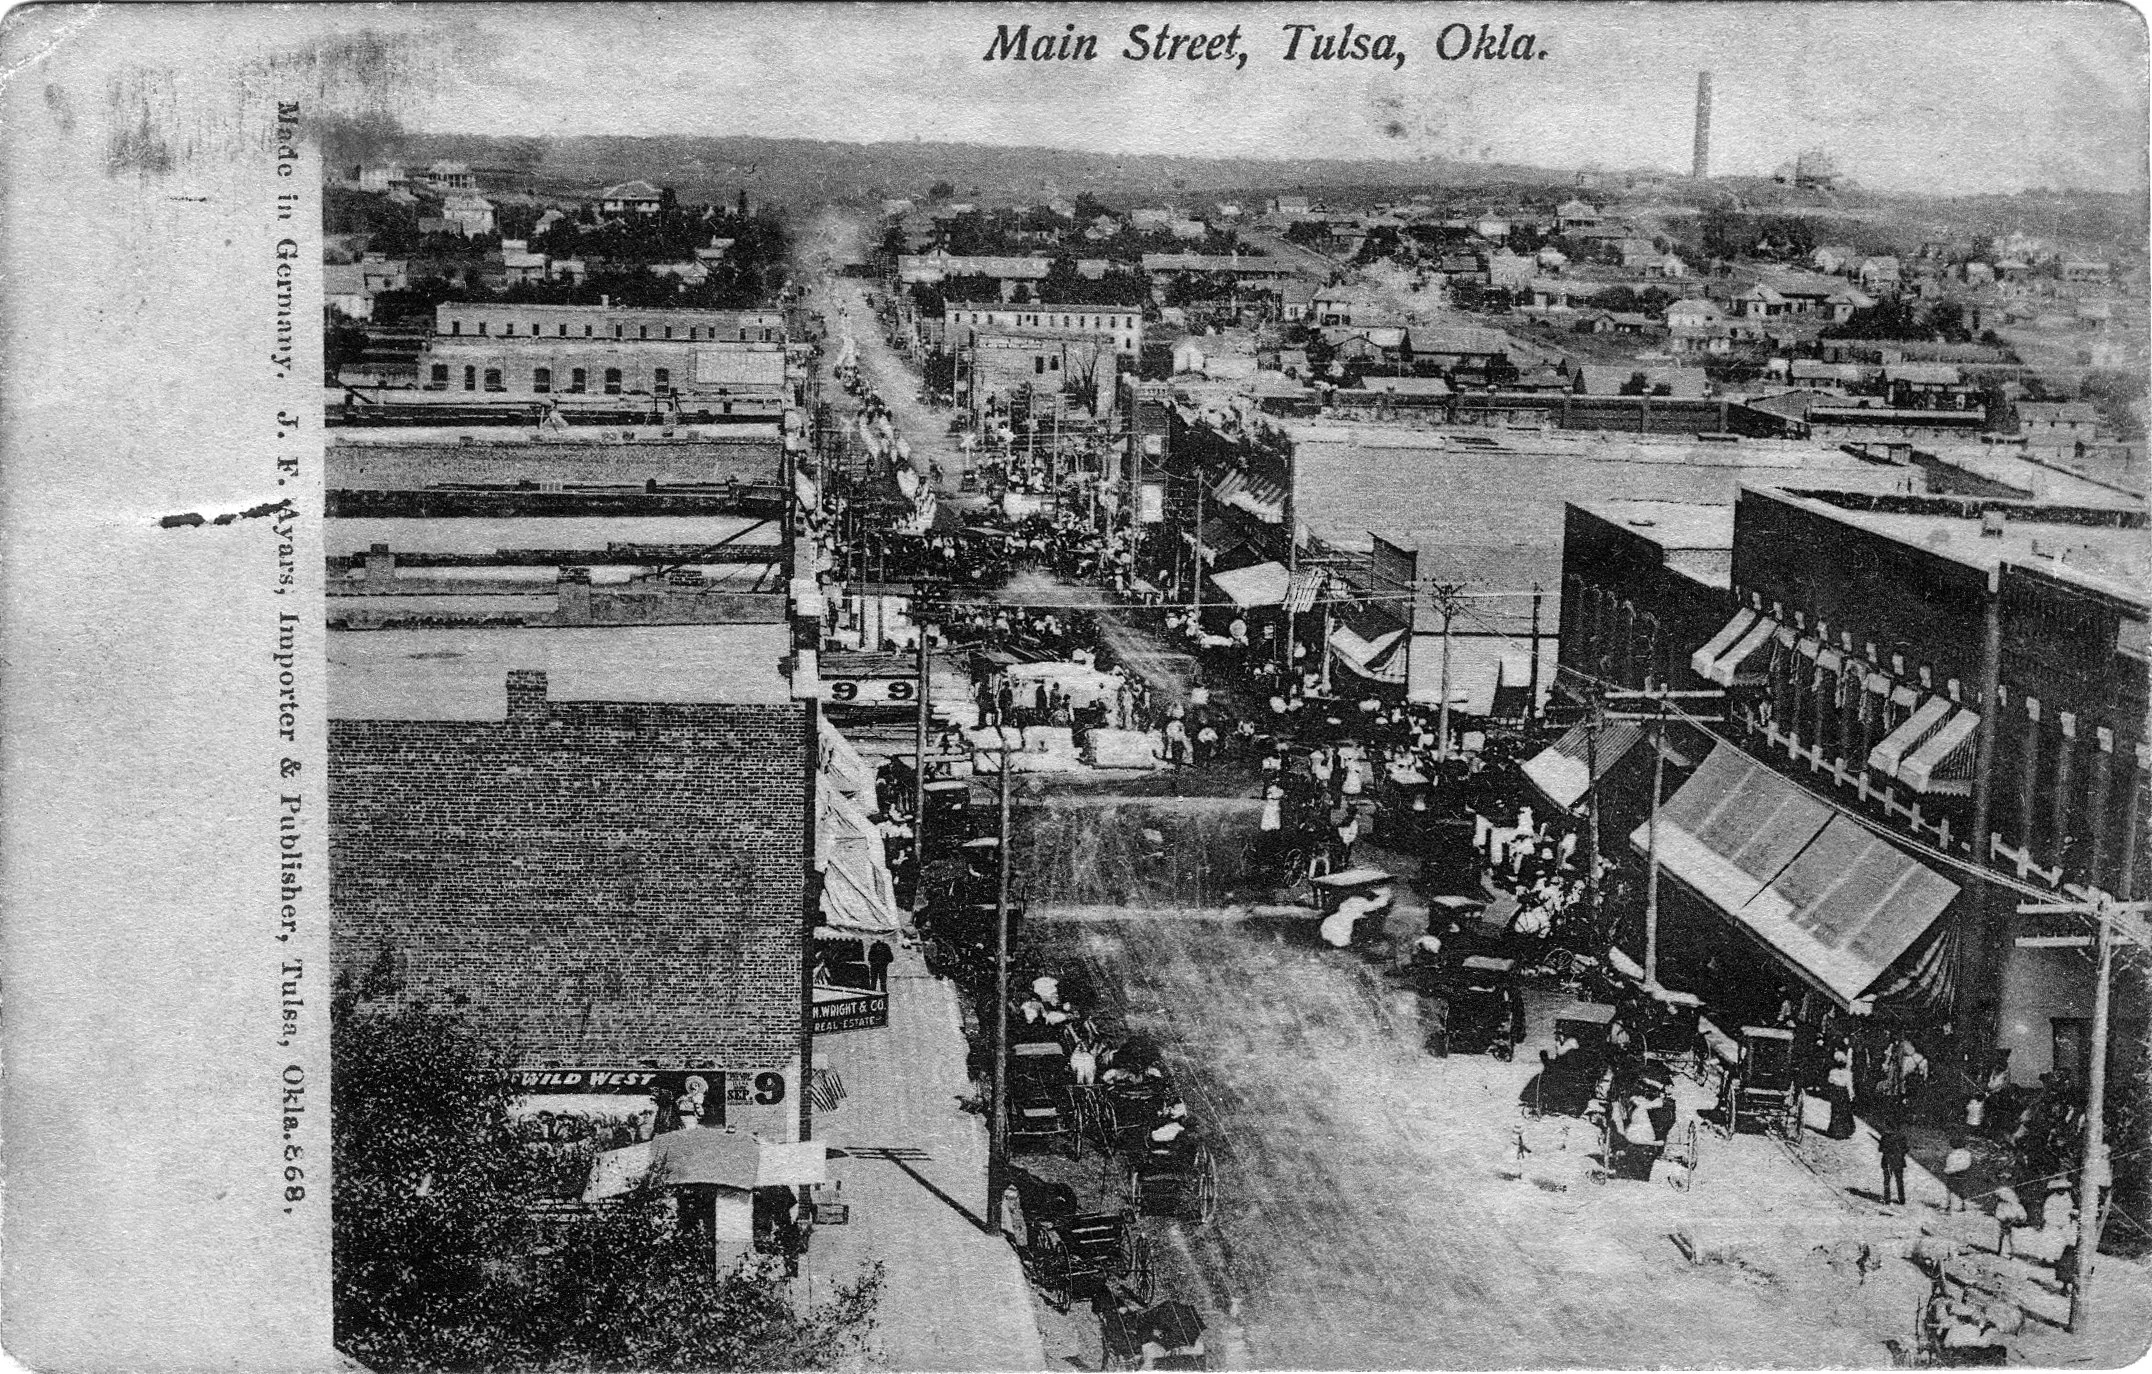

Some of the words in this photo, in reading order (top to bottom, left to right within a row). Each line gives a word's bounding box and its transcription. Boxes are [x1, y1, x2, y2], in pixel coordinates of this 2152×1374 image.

[831, 681, 858, 701] 9
[887, 681, 914, 701] 9
[859, 1000, 868, 1013] &
[870, 999, 887, 1012] CO.
[814, 1021, 838, 1032] REAL
[843, 1016, 876, 1029] ESTATE
[521, 1072, 582, 1086] WILD
[589, 1071, 657, 1086] WEST
[726, 1089, 753, 1101] SEP.
[754, 1071, 785, 1106] 9
